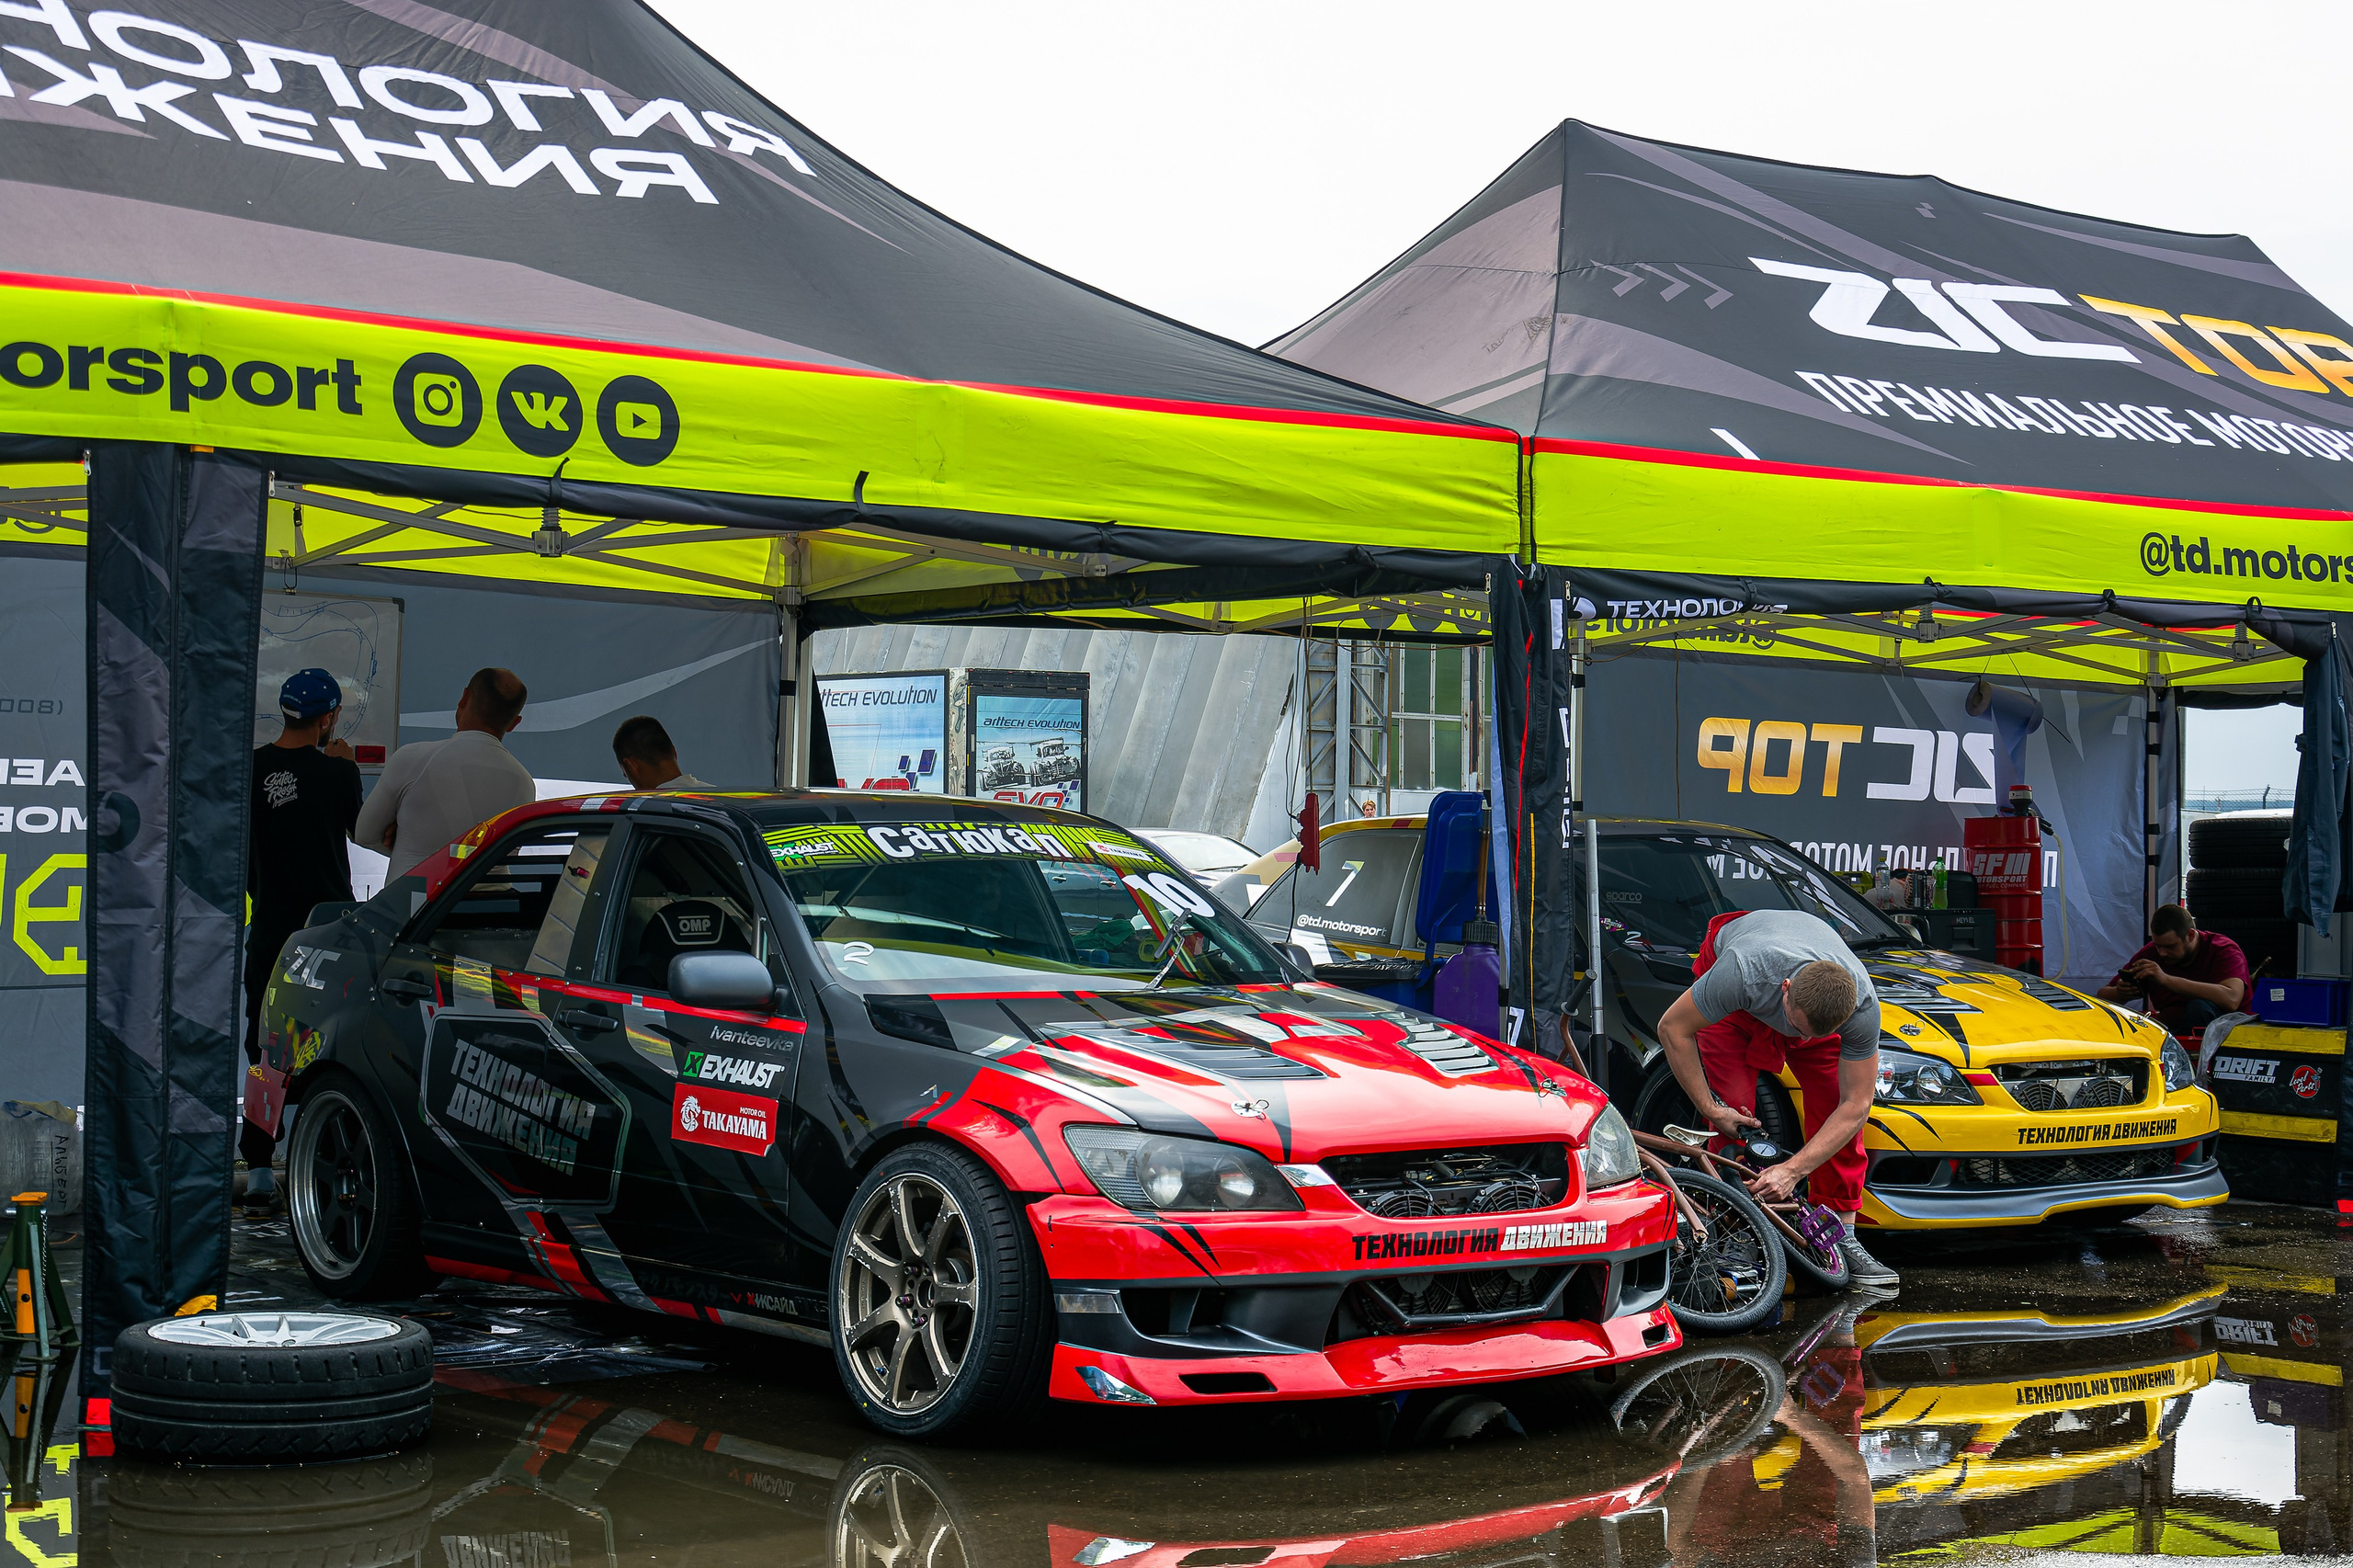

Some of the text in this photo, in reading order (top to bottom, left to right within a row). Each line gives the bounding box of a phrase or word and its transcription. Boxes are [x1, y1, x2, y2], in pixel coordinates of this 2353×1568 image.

[0, 45, 720, 205] ЖЕНИЯ
[1747, 256, 2142, 364] ZIC
[1794, 370, 2216, 447] ПРЕМИАЛЬНОЕ
[770, 842, 835, 858] EXHAUST
[1121, 872, 1216, 918] 10
[1324, 860, 1365, 907] 7
[678, 918, 711, 933] OMP
[1297, 914, 1388, 937] @td.motorsport
[699, 1053, 785, 1089] EXHAUST
[2213, 1056, 2281, 1076] DRIFT
[2245, 1074, 2277, 1085] FAMILY
[450, 1038, 597, 1142] ТЕХНОЛОГИЯ
[446, 1082, 578, 1177] ДВИЖЕНИЯ
[701, 1109, 767, 1141] TAKAYAMA
[739, 1106, 767, 1119] MOTOR OIL
[2018, 1118, 2177, 1145] ТЕХНОЛОГИЯ ДВИЖЕНИЯ
[1351, 1220, 1608, 1261] ТЕХНОЛОГИЯ ДВИЖЕНИЯ
